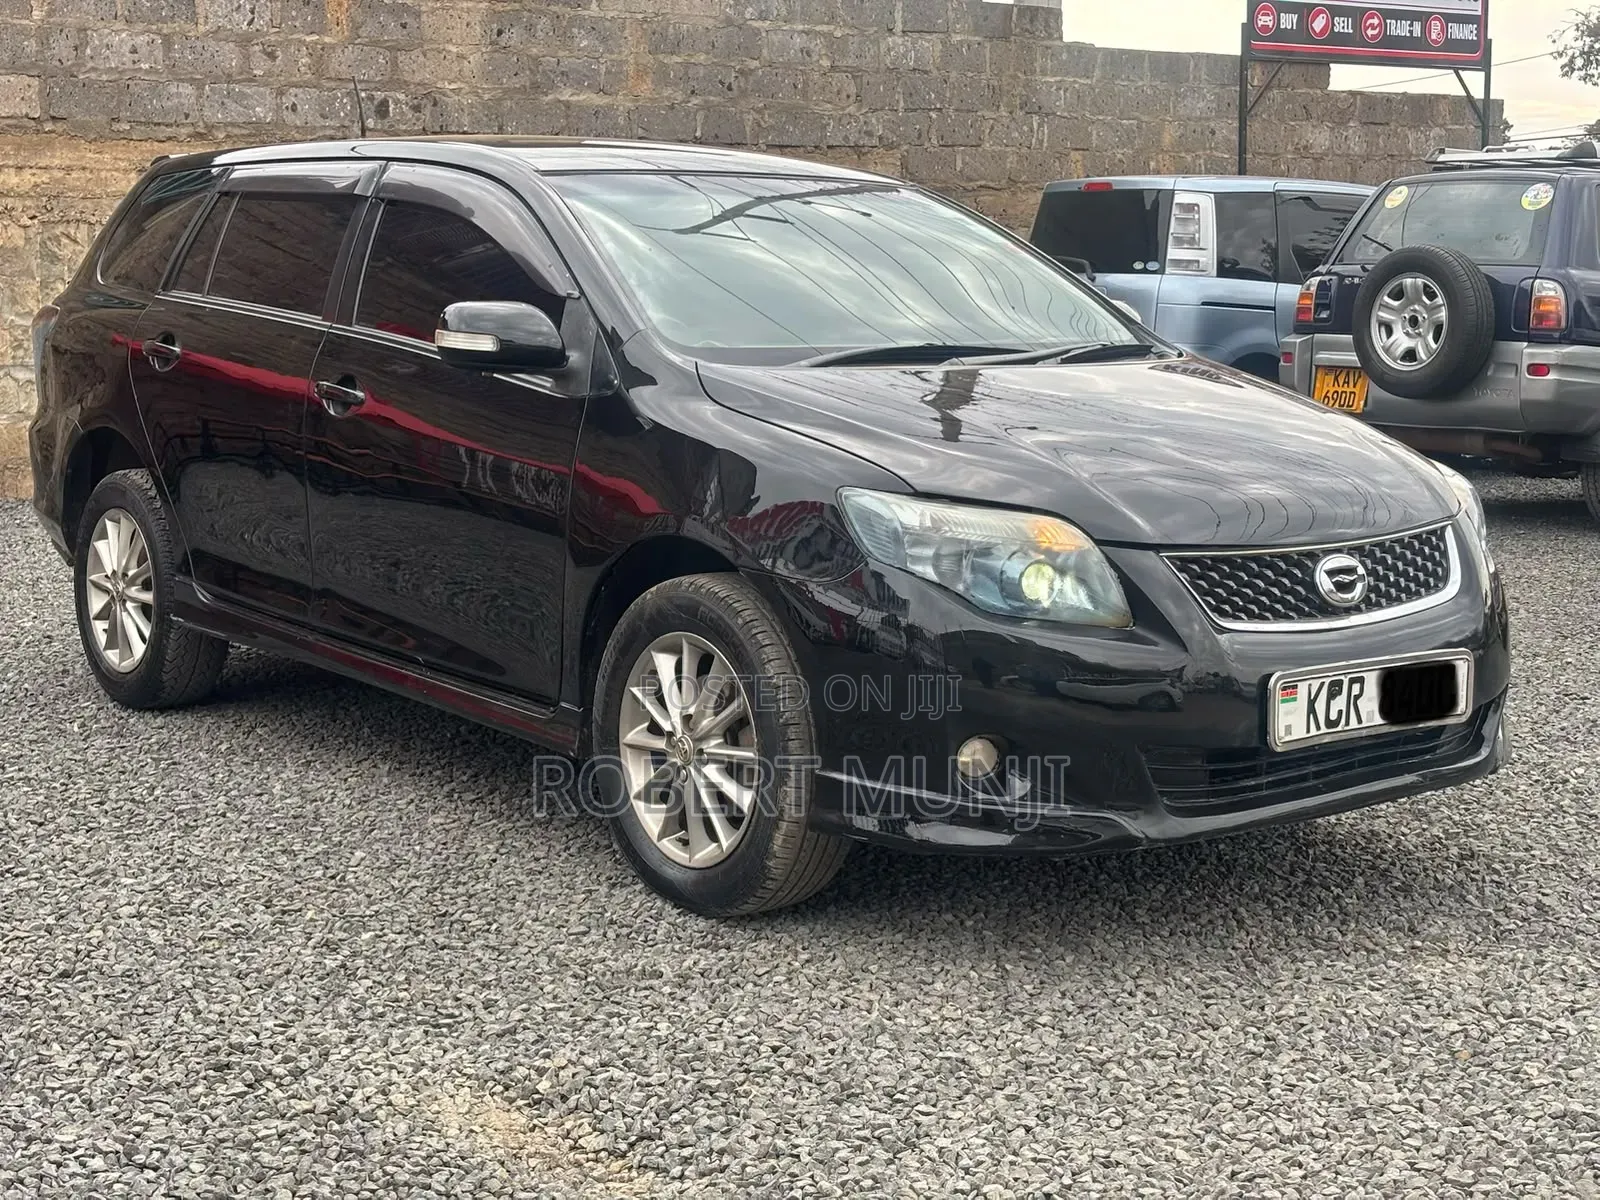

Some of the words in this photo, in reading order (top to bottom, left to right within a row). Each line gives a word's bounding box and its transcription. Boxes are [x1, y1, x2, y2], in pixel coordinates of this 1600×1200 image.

[1280, 13, 1298, 30] BUY
[1333, 17, 1353, 33] SELL
[1386, 19, 1421, 37] TRADE-IN
[1447, 22, 1478, 40] FINANCE
[1332, 368, 1362, 388] KAV
[1305, 675, 1365, 734] KCR
